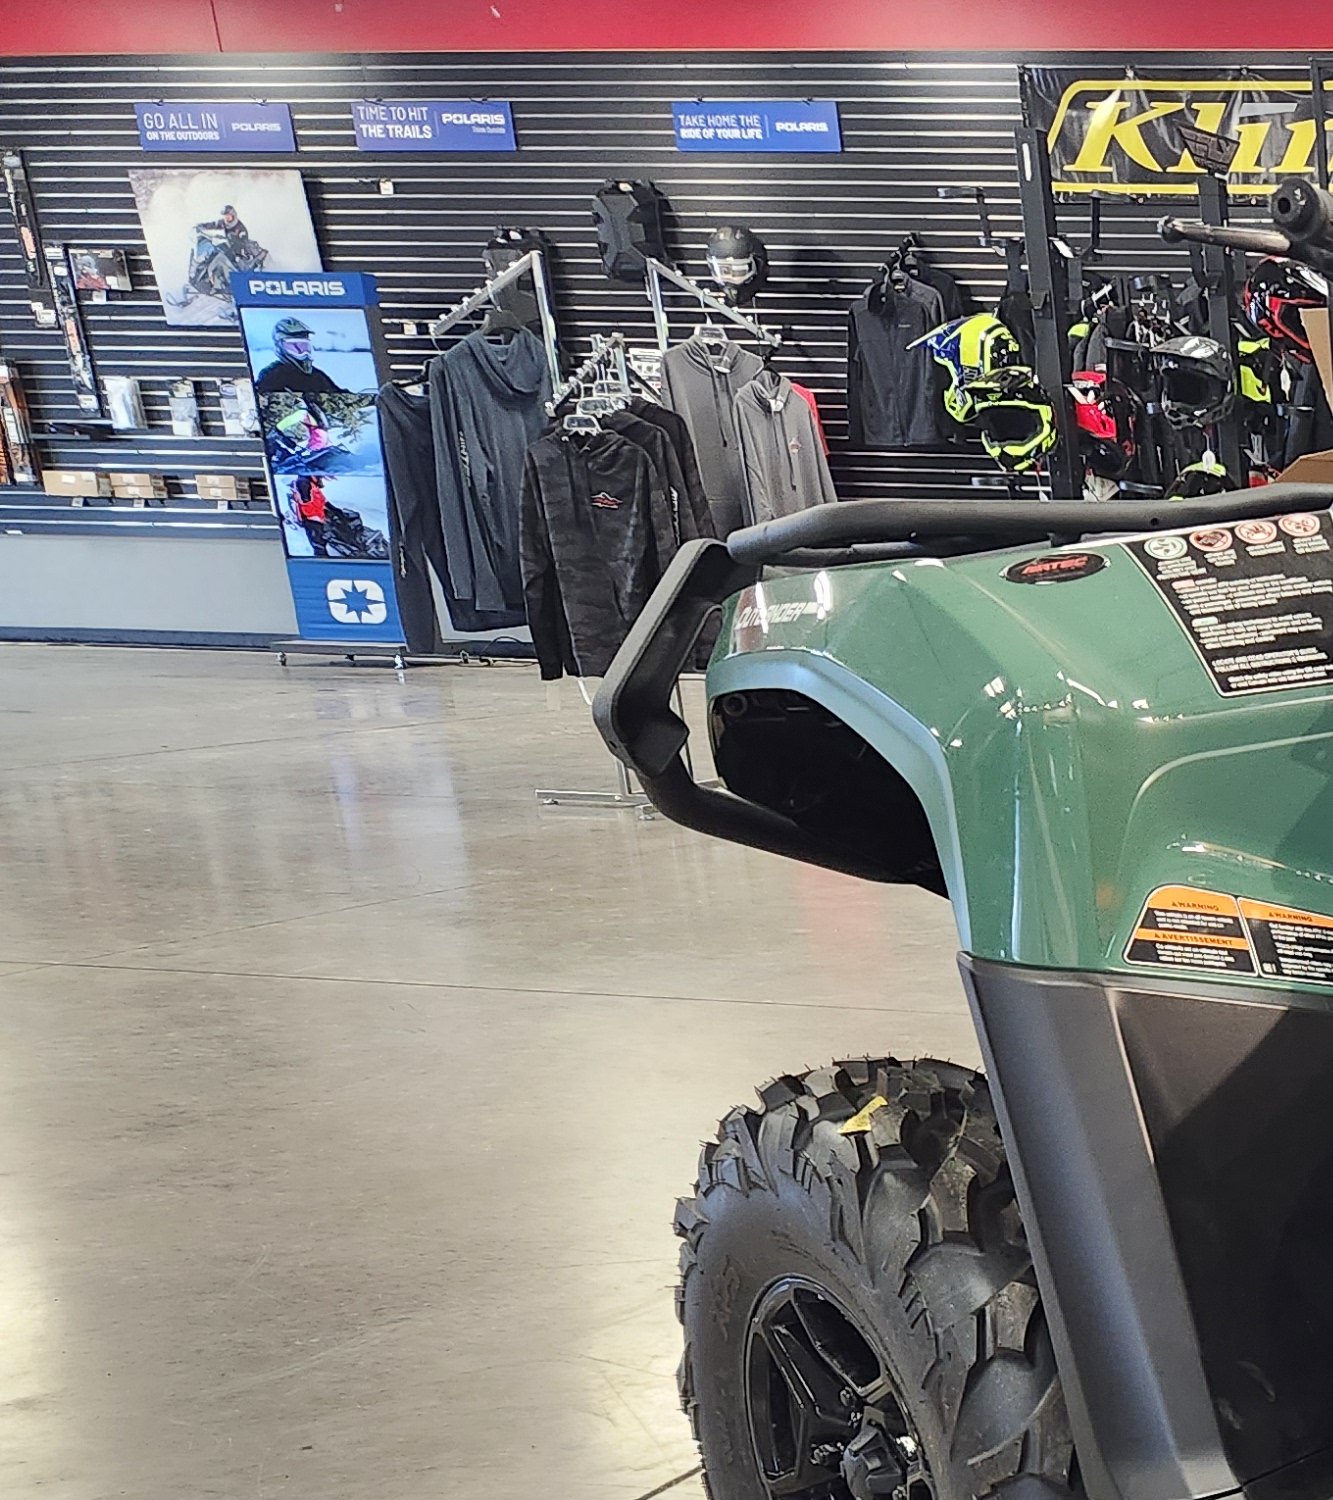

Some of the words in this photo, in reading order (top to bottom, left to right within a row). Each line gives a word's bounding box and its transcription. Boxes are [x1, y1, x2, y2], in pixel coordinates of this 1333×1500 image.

[357, 106, 388, 121] TIME
[389, 106, 407, 121] TO
[408, 107, 428, 121] HIT
[441, 113, 505, 125] POLARIS
[143, 113, 164, 129] GO
[169, 113, 198, 129] ALL
[202, 113, 218, 129] IN
[231, 123, 281, 132] POLARIS
[678, 114, 705, 128] TAKE
[707, 114, 737, 128] HOME
[739, 114, 761, 128] THE
[775, 121, 829, 132] POLARIS
[146, 131, 159, 140] ON
[159, 131, 177, 140] THE
[176, 131, 220, 140] OUTDOORS
[360, 124, 386, 138] THE
[386, 124, 432, 139] TRAILS
[680, 128, 701, 139] RIDE
[702, 128, 715, 139] OF
[715, 128, 742, 139] YOUR
[742, 128, 763, 140] LIFE
[249, 280, 346, 297] POLARIS
[735, 602, 806, 630] OUTANDER
[1178, 901, 1220, 912] WARNING
[1274, 912, 1314, 923] WARNING
[1162, 933, 1233, 947] AVERTISSEMENT
